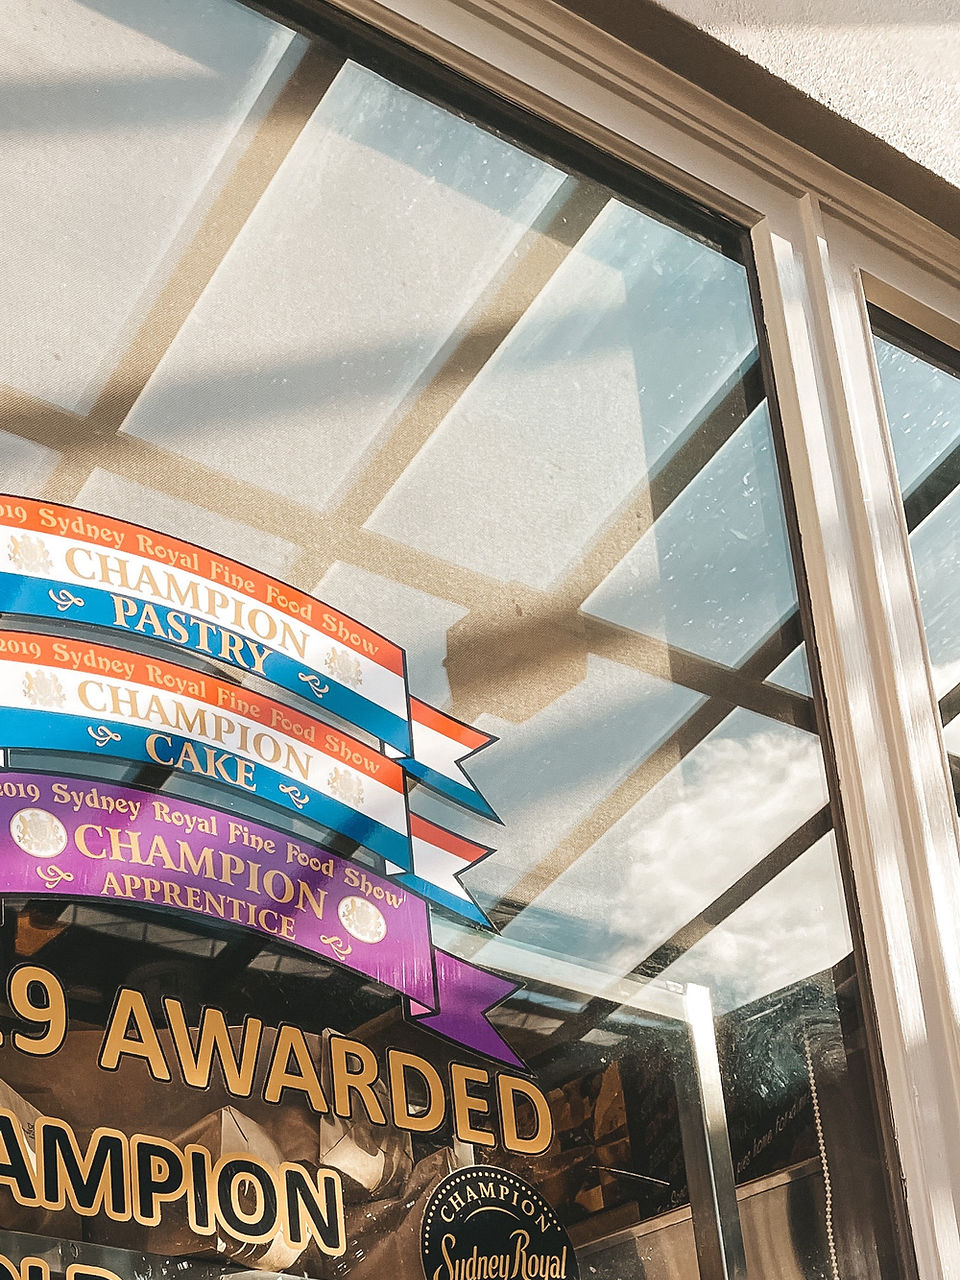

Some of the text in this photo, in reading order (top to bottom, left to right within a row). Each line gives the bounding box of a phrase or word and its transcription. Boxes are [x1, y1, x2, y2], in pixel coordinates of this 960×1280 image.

[39, 508, 124, 548] Sydney
[138, 534, 199, 571] Royal
[211, 560, 255, 592] Fine
[266, 583, 312, 620] Food
[323, 614, 380, 656] Show
[65, 547, 310, 658] CHAMPION
[111, 594, 273, 676] PASTRY
[53, 643, 134, 681] Sydney
[148, 665, 206, 700] Royal
[217, 690, 261, 720] Fine
[271, 709, 315, 742] Food
[325, 736, 380, 774] Show
[78, 680, 313, 780] CHAMPION
[145, 733, 257, 792] CAKE
[52, 784, 140, 818] Sydney
[154, 802, 218, 836] Royal
[228, 823, 275, 855] Fine
[287, 843, 335, 877] Food
[344, 870, 404, 909] Show
[74, 824, 328, 919] CHAMPION
[101, 872, 297, 940] APPRENTICE
[98, 986, 555, 1157] AWARDED
[440, 1181, 551, 1234] CHAMPION
